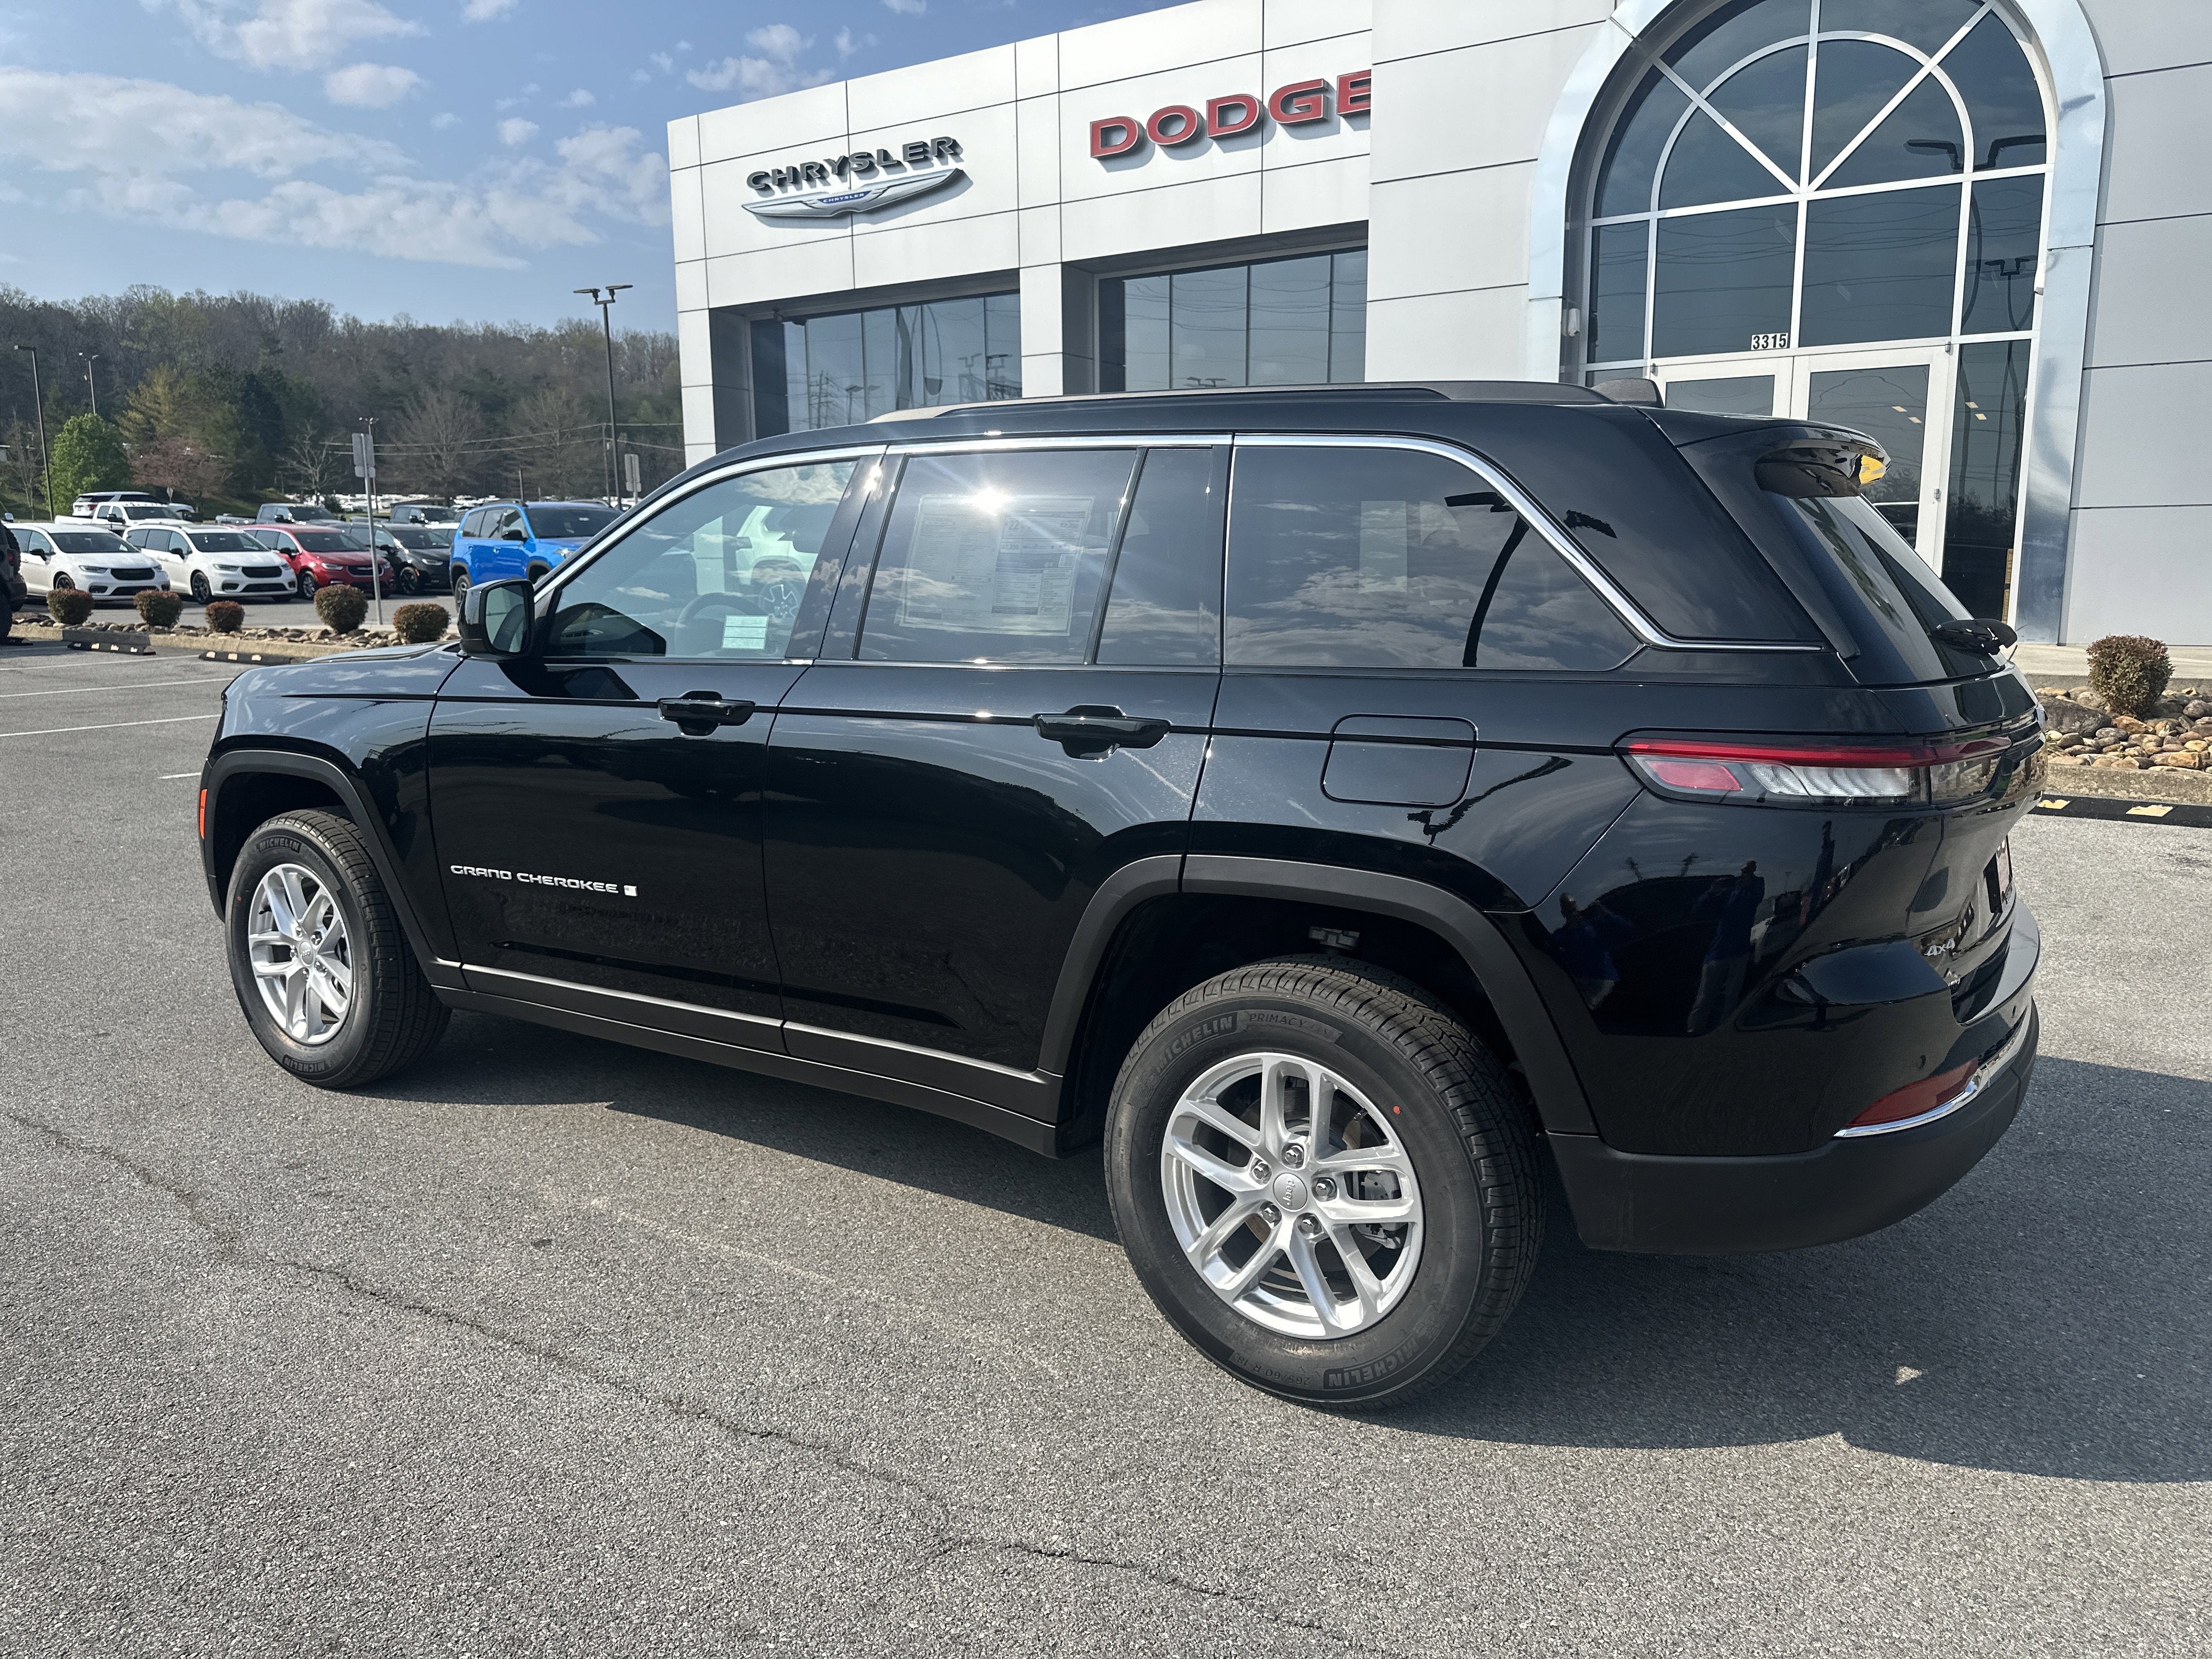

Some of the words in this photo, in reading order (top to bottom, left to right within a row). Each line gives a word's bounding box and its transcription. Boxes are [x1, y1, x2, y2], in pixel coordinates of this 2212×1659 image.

[1091, 69, 1371, 157] DODGE
[747, 136, 955, 189] CHRYSLER
[823, 193, 865, 203] CHRYSLER
[1753, 334, 1786, 349] 3315
[259, 838, 299, 851] MICHELIN
[450, 865, 512, 879] GRAND
[517, 873, 619, 893] CHEROKEE
[1250, 1013, 1307, 1028] PRIMACY
[1155, 1015, 1233, 1073] MICHELIN
[284, 1057, 325, 1072] MICHELIN
[1237, 1356, 1248, 1367] 18
[1253, 1364, 1262, 1373] R
[1329, 1337, 1419, 1387] MICHELIN
[1265, 1369, 1311, 1387] 265/60
